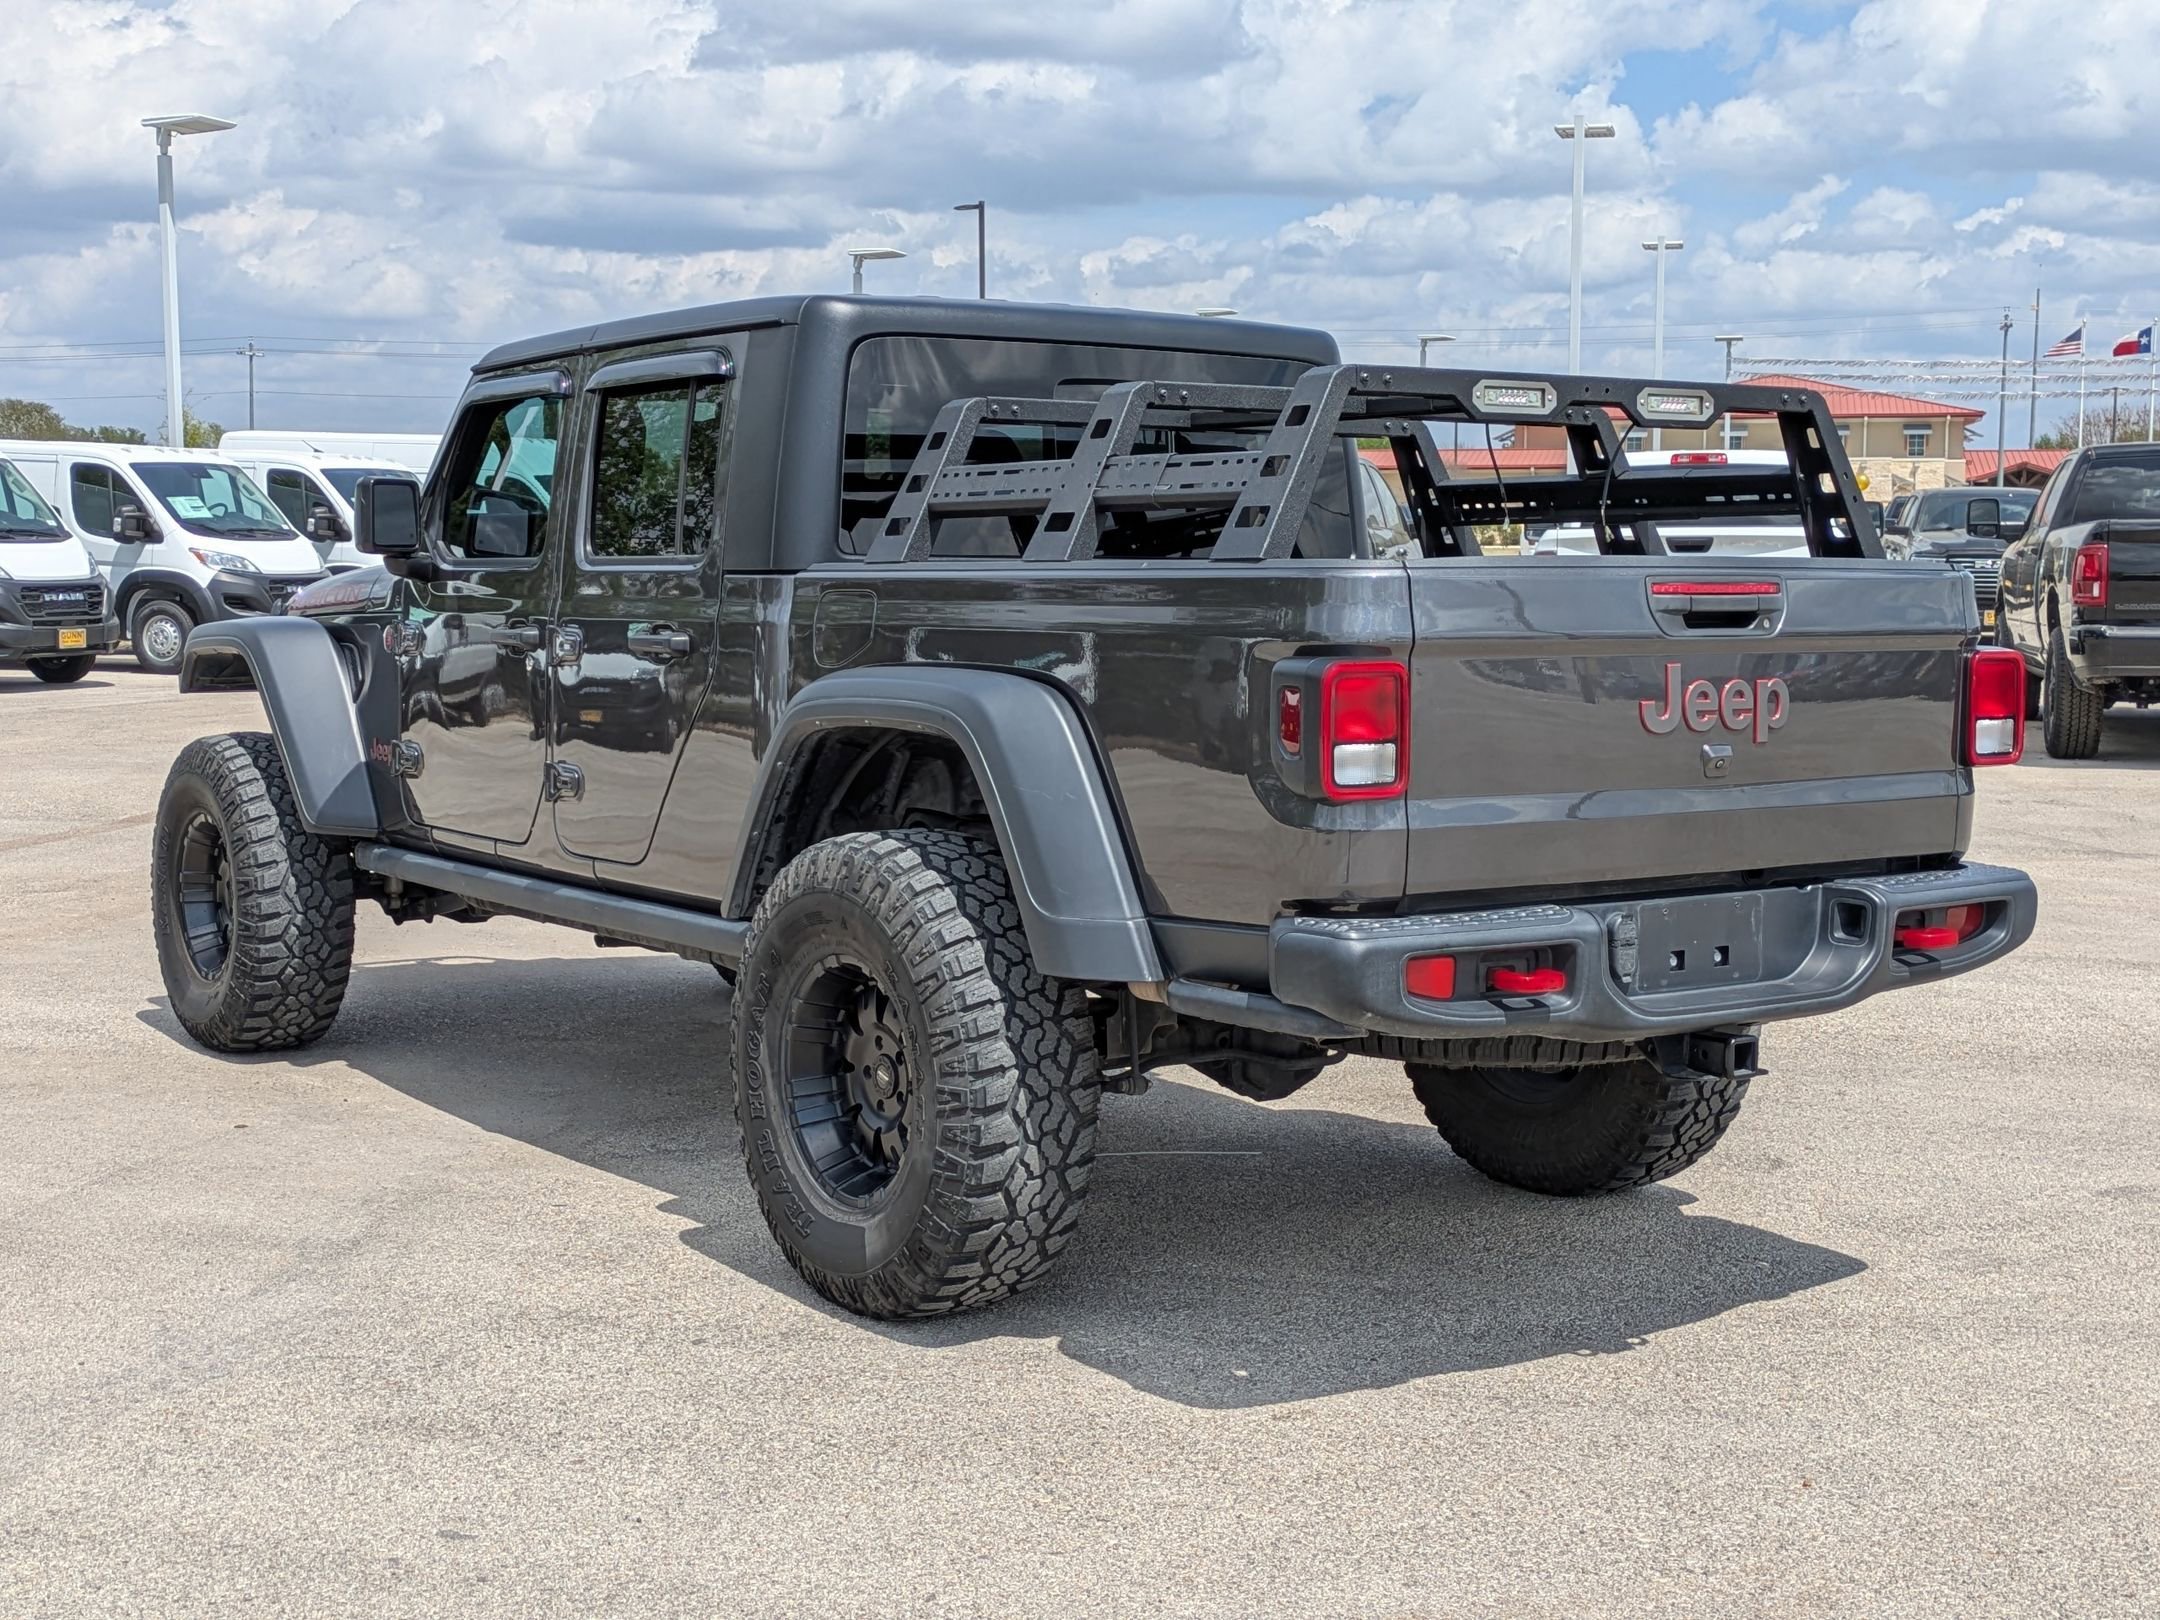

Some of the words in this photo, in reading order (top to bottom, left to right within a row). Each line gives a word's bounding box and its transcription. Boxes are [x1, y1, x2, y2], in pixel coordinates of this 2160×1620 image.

[44, 592, 85, 601] RAM
[1638, 662, 1790, 744] Jeep
[747, 1030, 766, 1119] HOG
[757, 1128, 816, 1239] TRAIL
